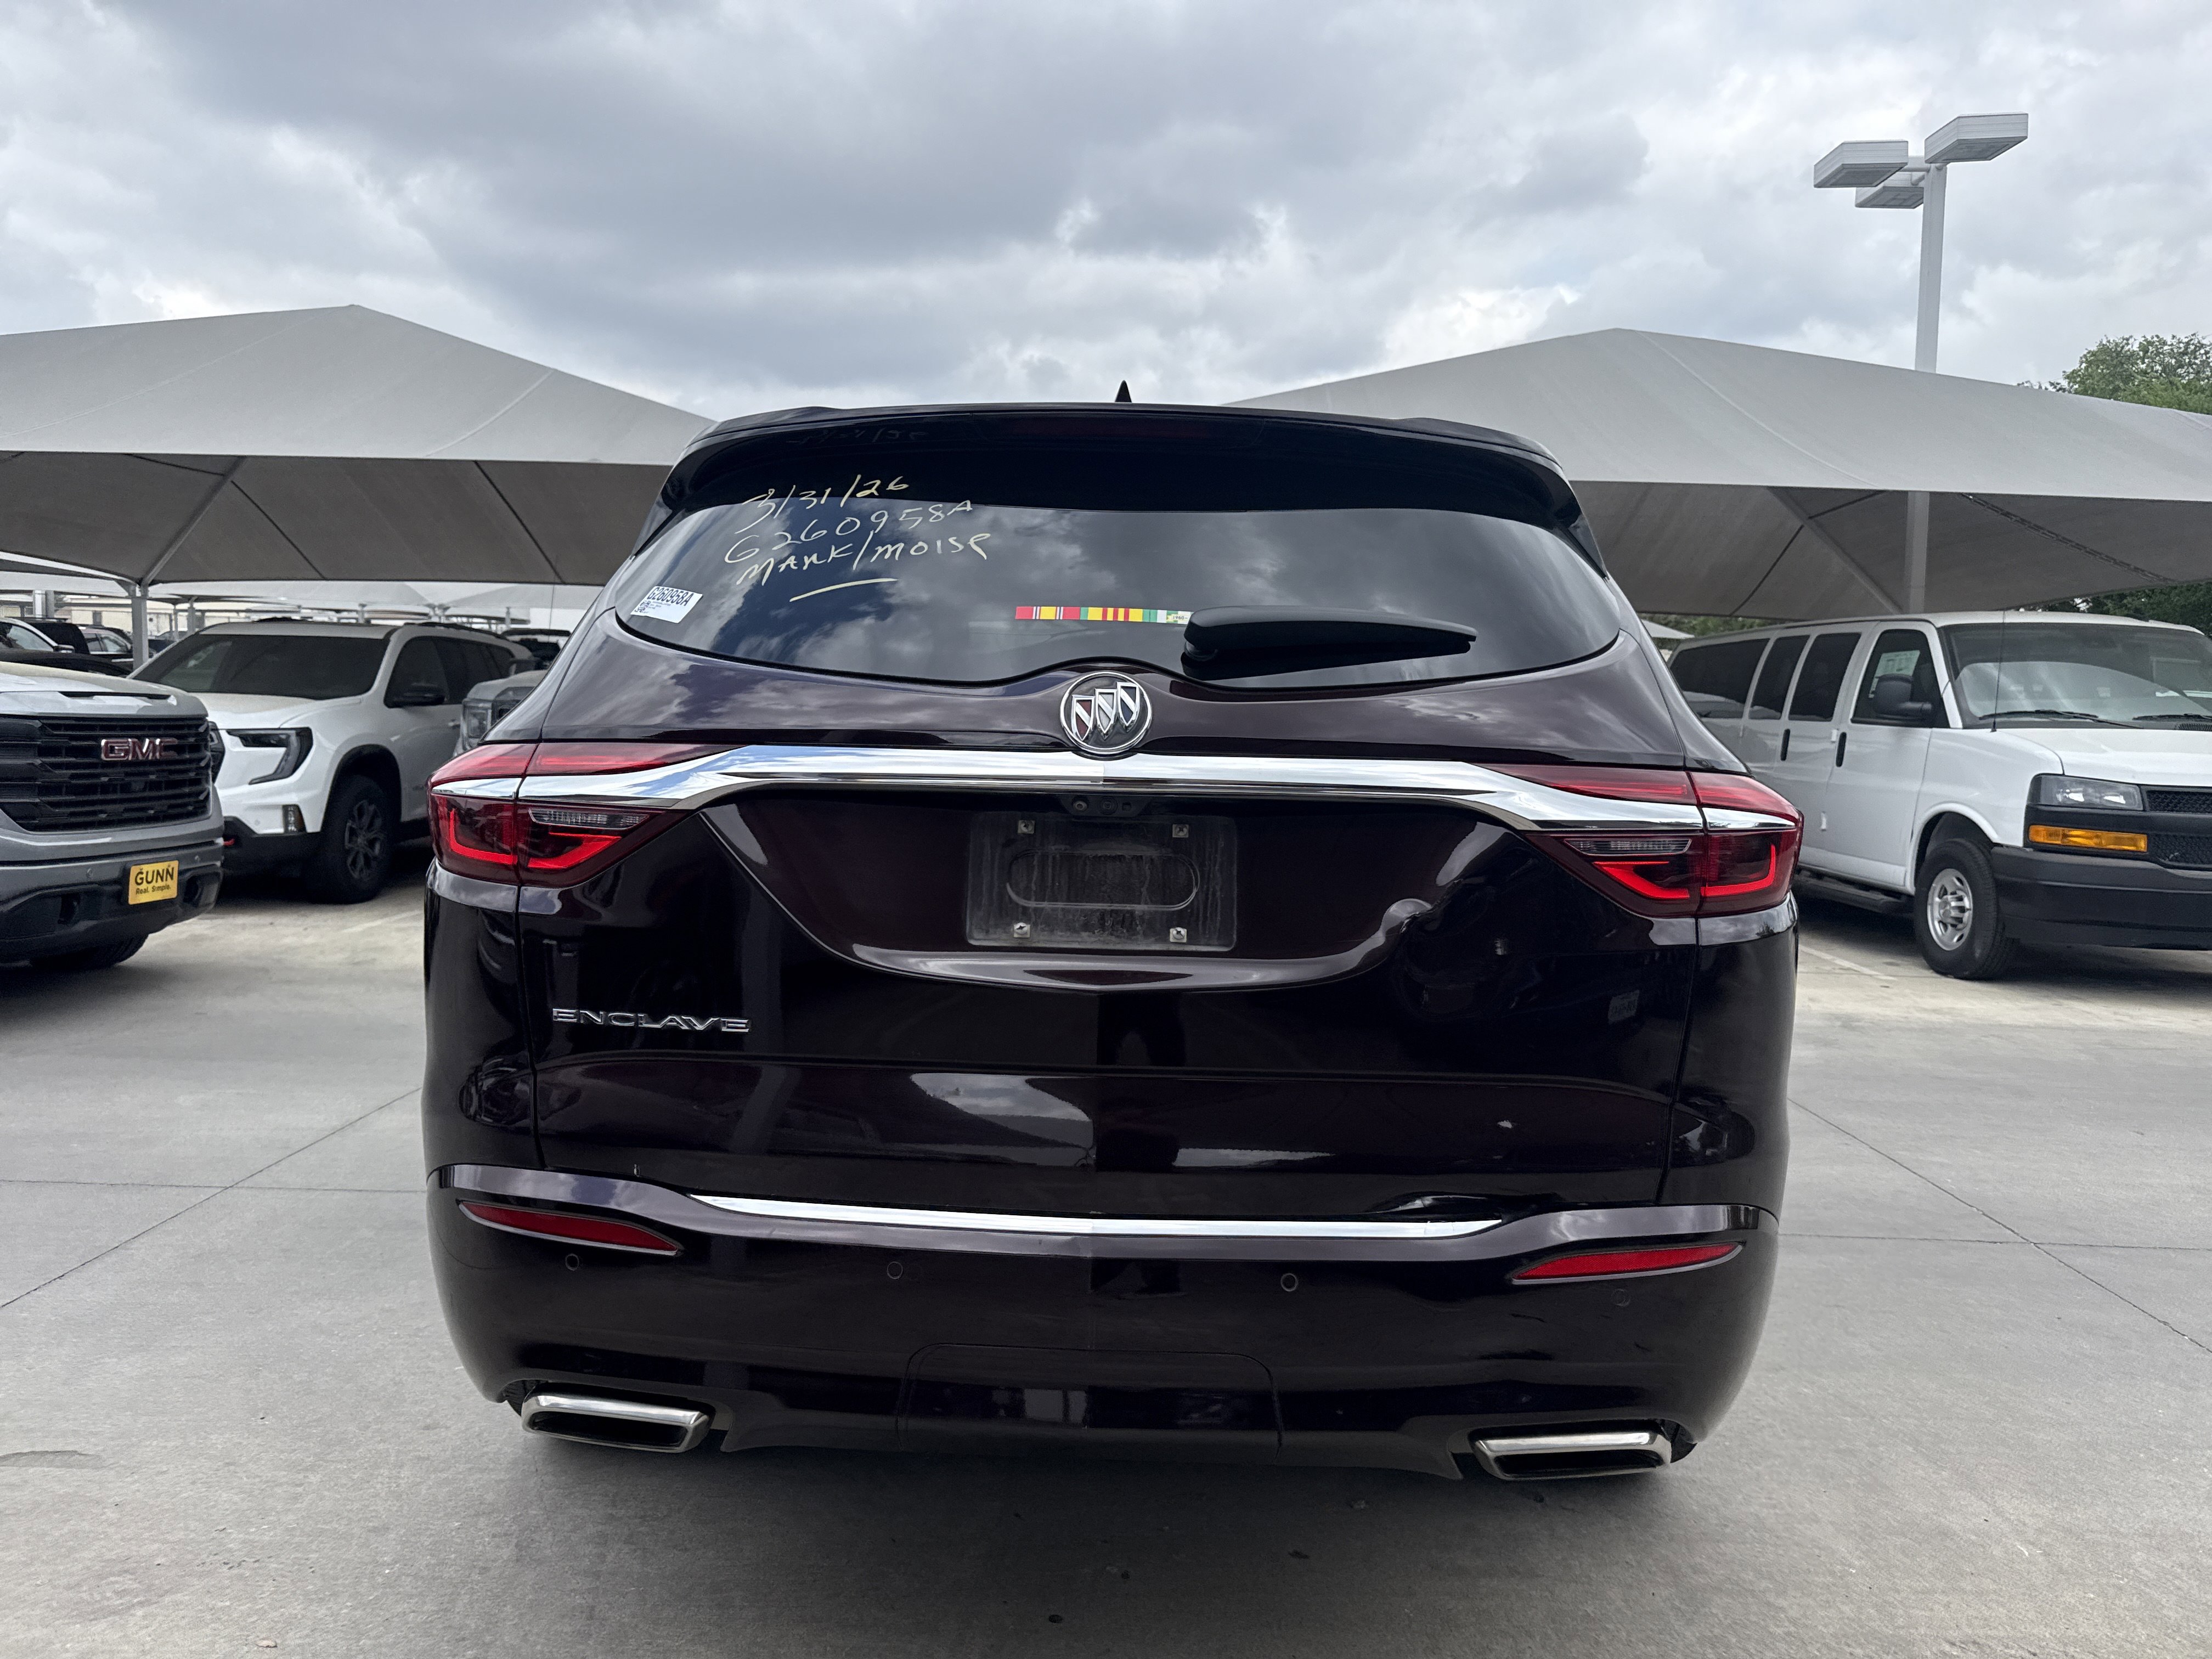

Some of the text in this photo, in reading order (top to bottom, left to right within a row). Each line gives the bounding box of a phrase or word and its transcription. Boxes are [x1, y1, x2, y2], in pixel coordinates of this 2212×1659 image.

[734, 474, 909, 534] 3/31/26
[724, 500, 973, 563] G260958A
[646, 587, 695, 606] G260958A
[101, 738, 178, 761] GMC
[134, 867, 174, 886] GUNN
[136, 884, 171, 895] Real. Simple.
[552, 1008, 751, 1032] ENCLAVE
